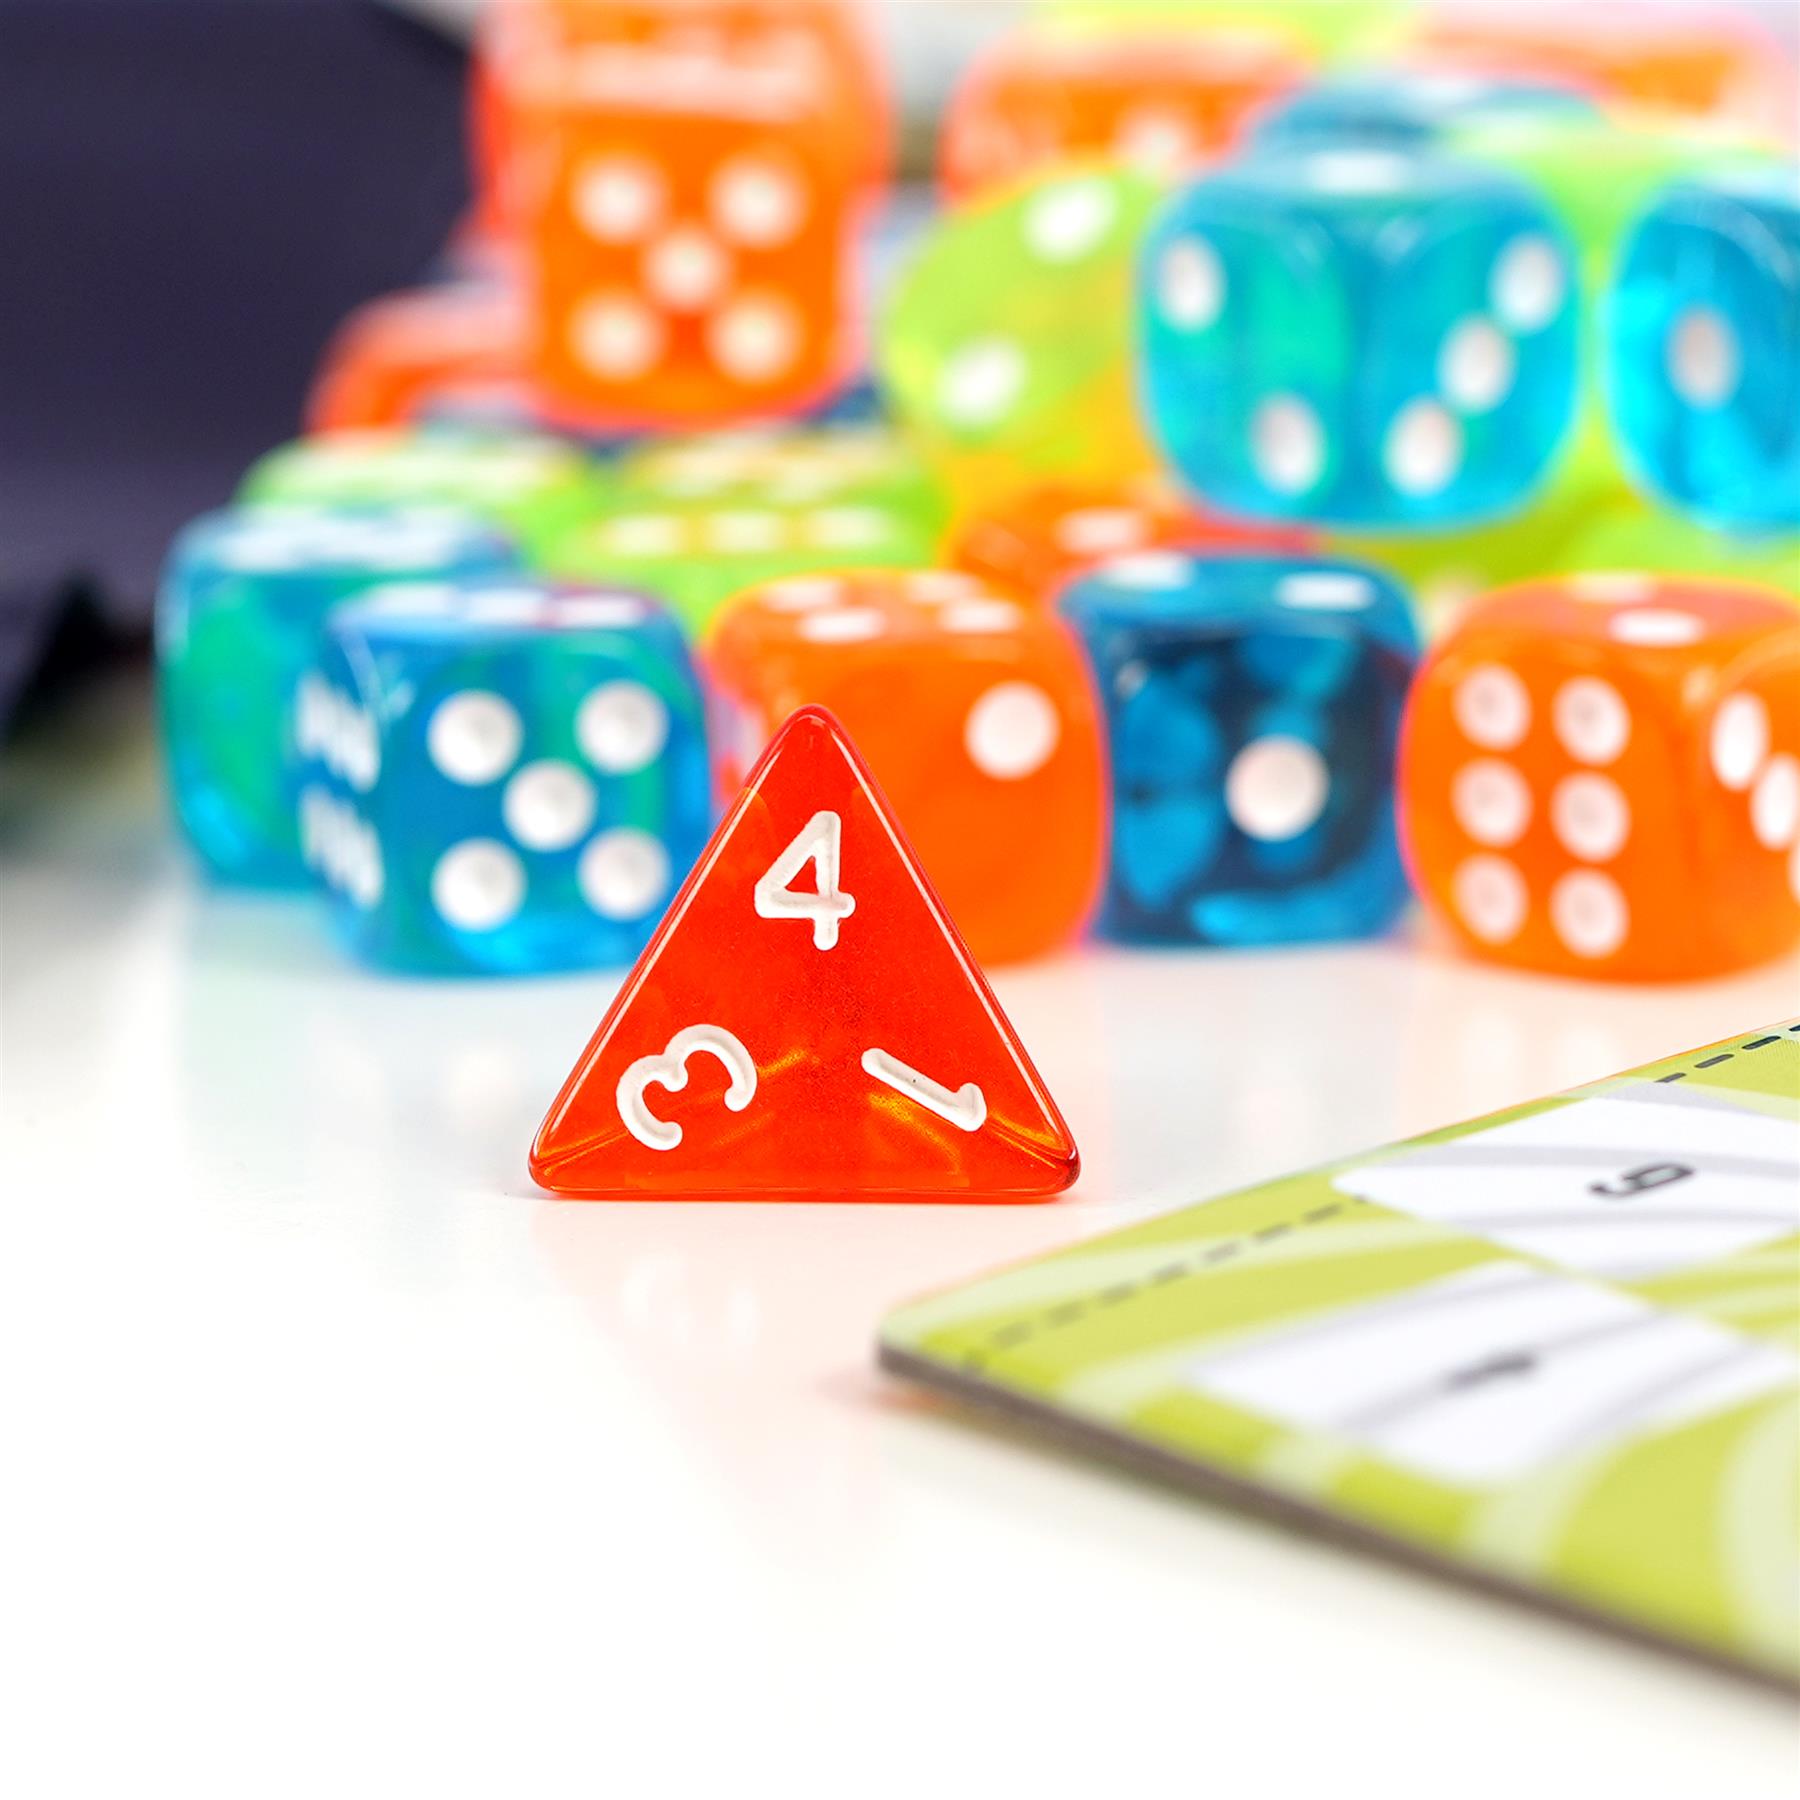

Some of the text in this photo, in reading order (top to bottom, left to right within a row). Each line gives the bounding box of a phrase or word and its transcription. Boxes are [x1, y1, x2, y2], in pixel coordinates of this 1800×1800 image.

[754, 810, 856, 951] 4
[615, 1023, 758, 1151] 3
[861, 1047, 988, 1132] 1
